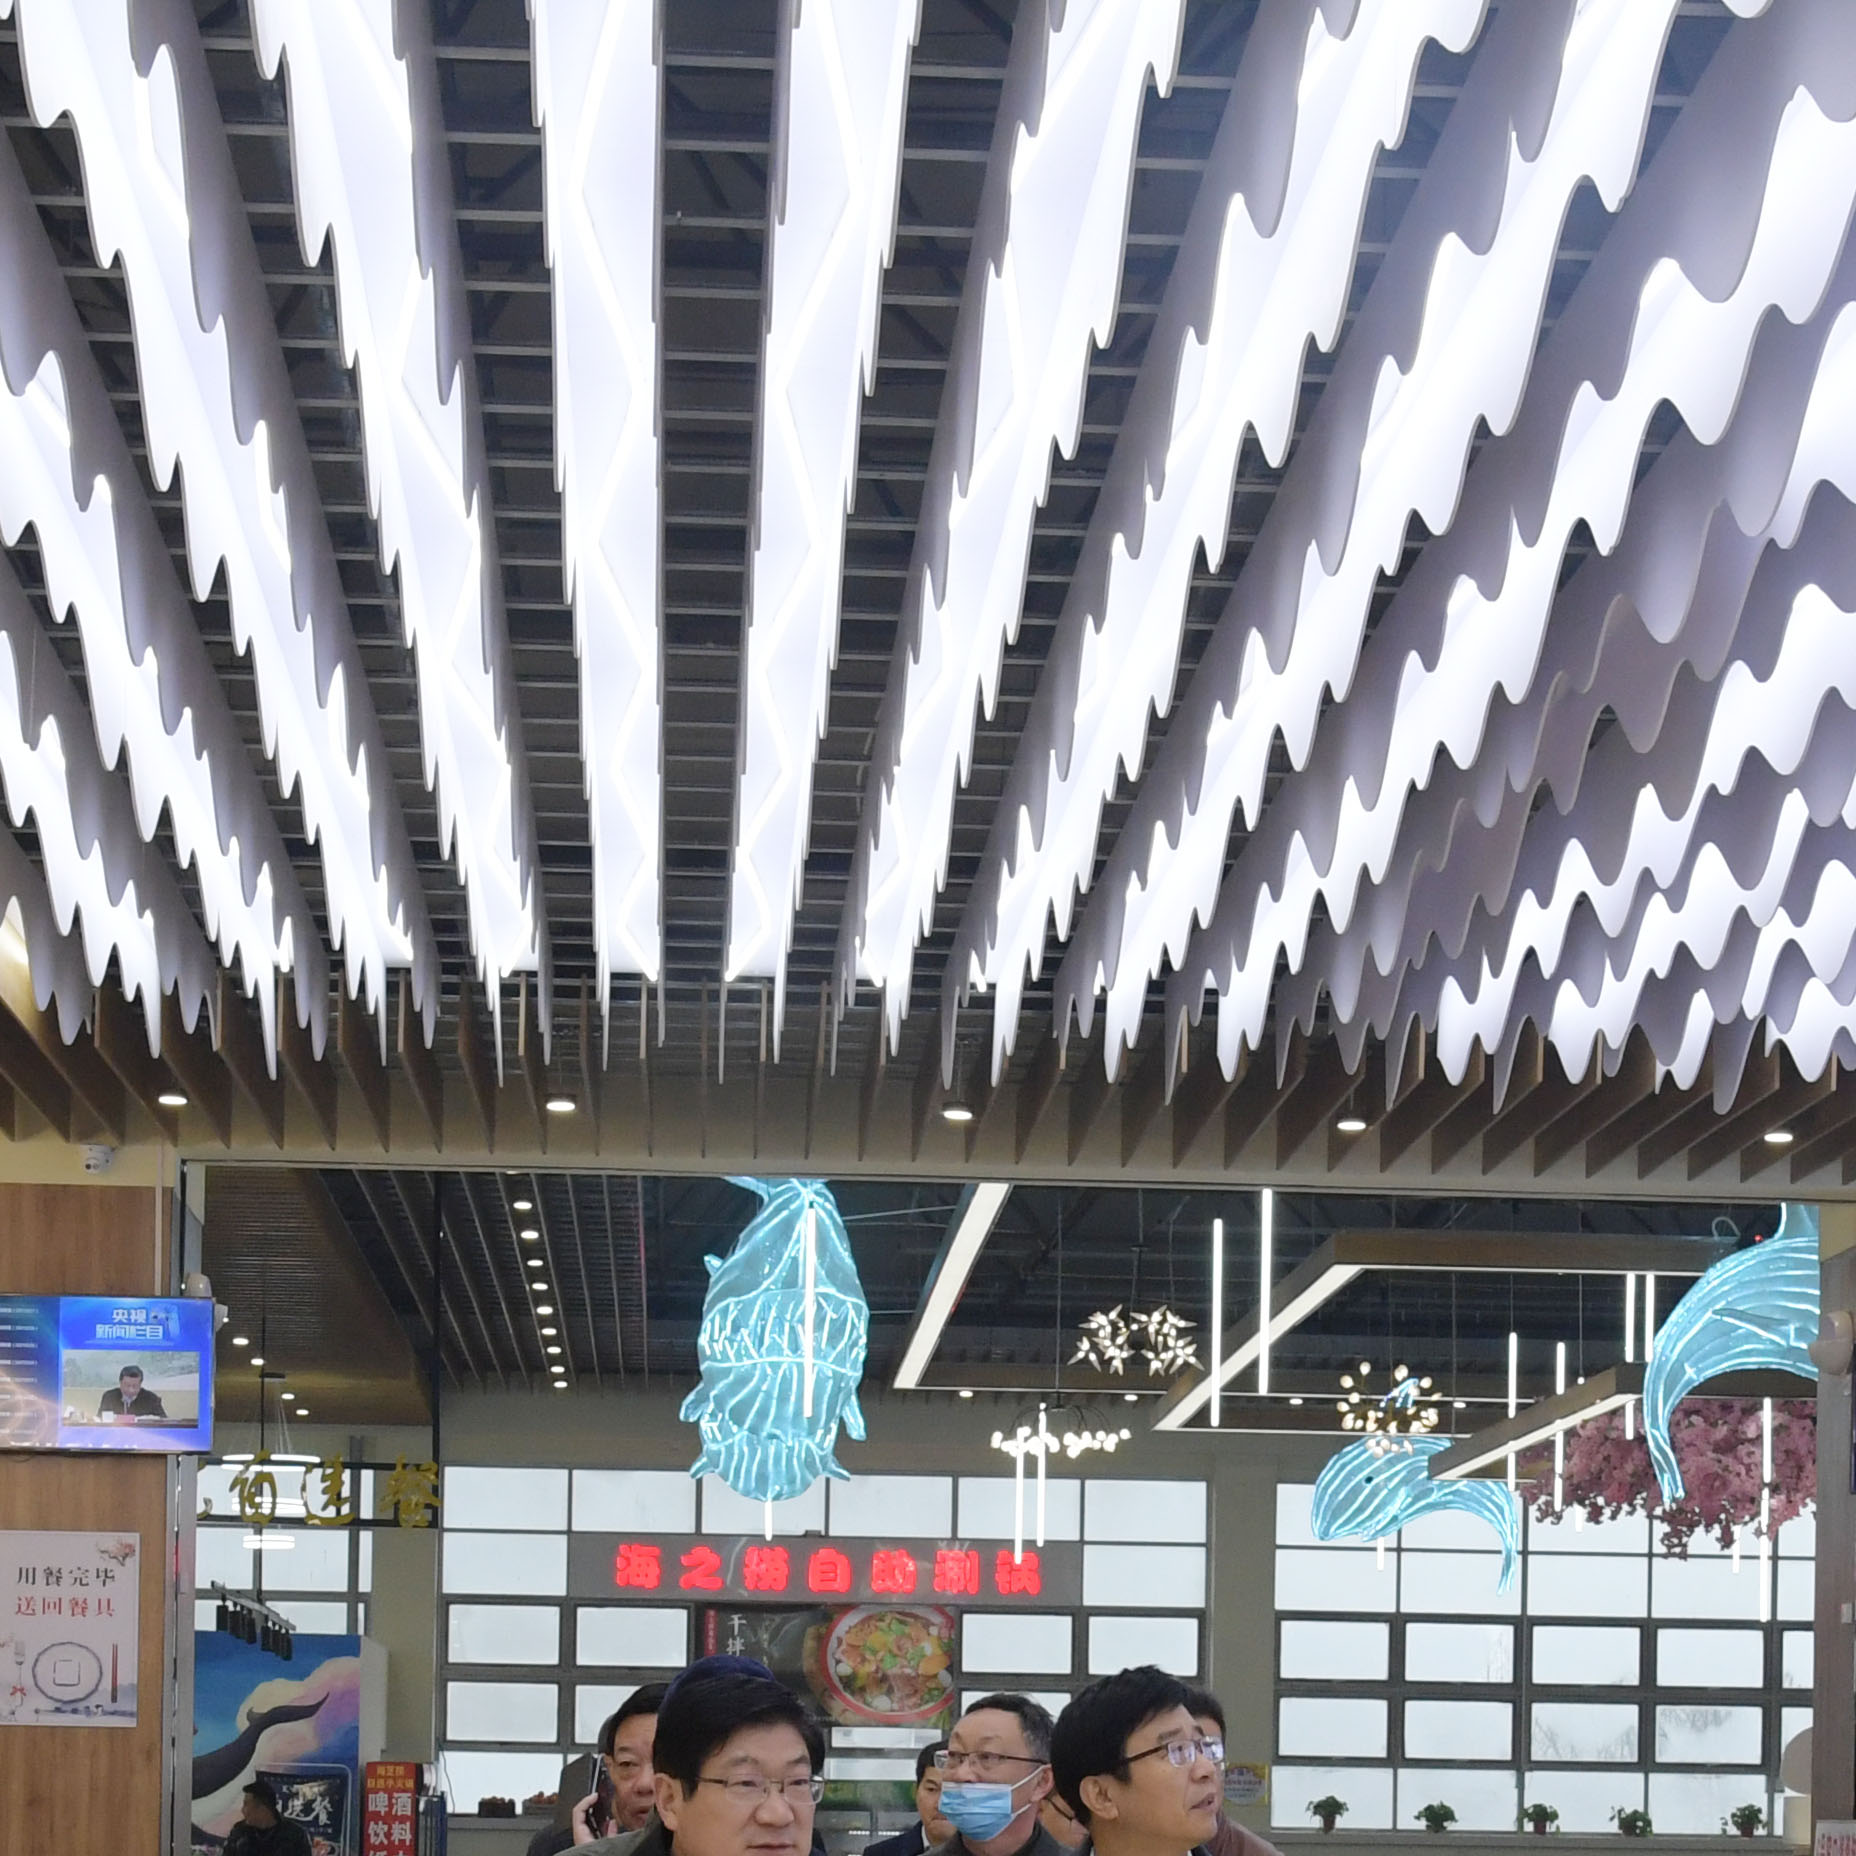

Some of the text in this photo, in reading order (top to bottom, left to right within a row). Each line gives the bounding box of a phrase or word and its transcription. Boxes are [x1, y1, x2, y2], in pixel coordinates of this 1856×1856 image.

[111, 1308, 147, 1323] 央视
[96, 1324, 163, 1339] 新闻栏目
[17, 1566, 116, 1587] 用餐完毕
[616, 1543, 1040, 1595] 海之捞自助涮锅
[15, 1596, 115, 1617] 送回餐具
[368, 1792, 412, 1817] 啤酒
[368, 1821, 412, 1845] 饮料
